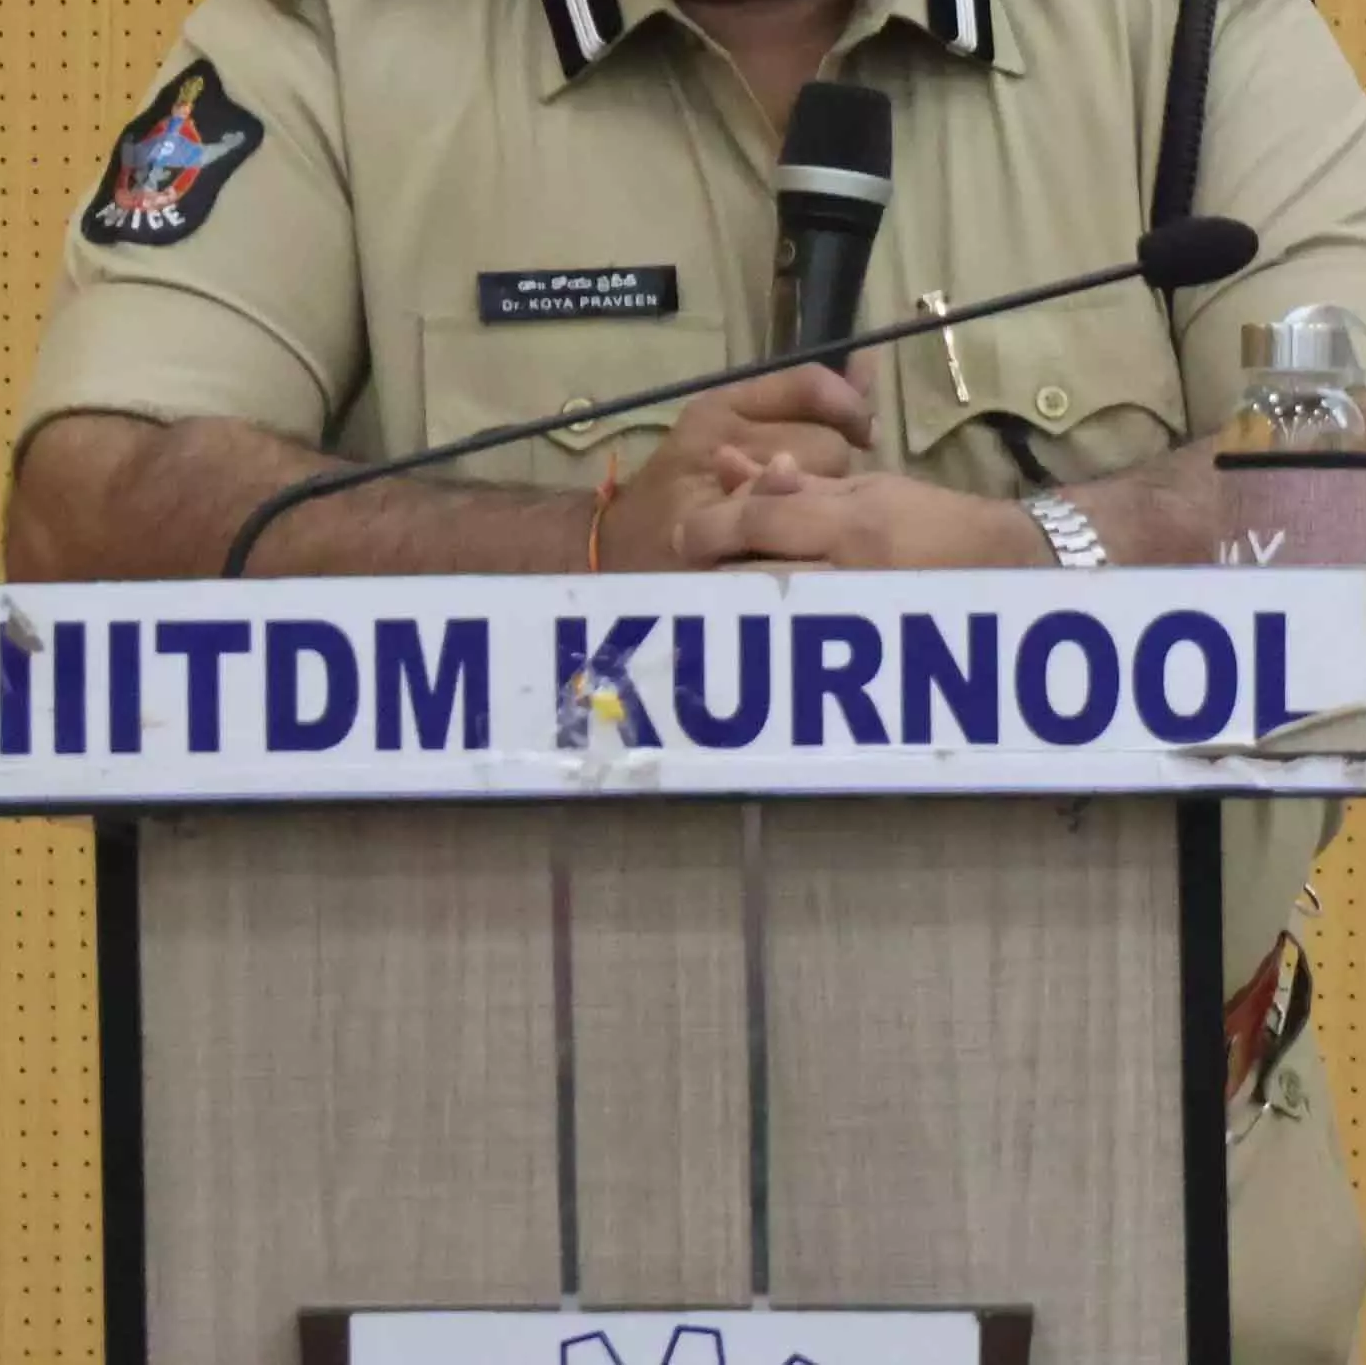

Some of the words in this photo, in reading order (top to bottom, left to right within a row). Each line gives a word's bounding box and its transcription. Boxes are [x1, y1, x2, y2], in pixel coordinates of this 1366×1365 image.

[529, 297, 574, 311] KOYA
[579, 293, 658, 309] PRAVEEN
[554, 609, 1321, 749] KURNOOL
